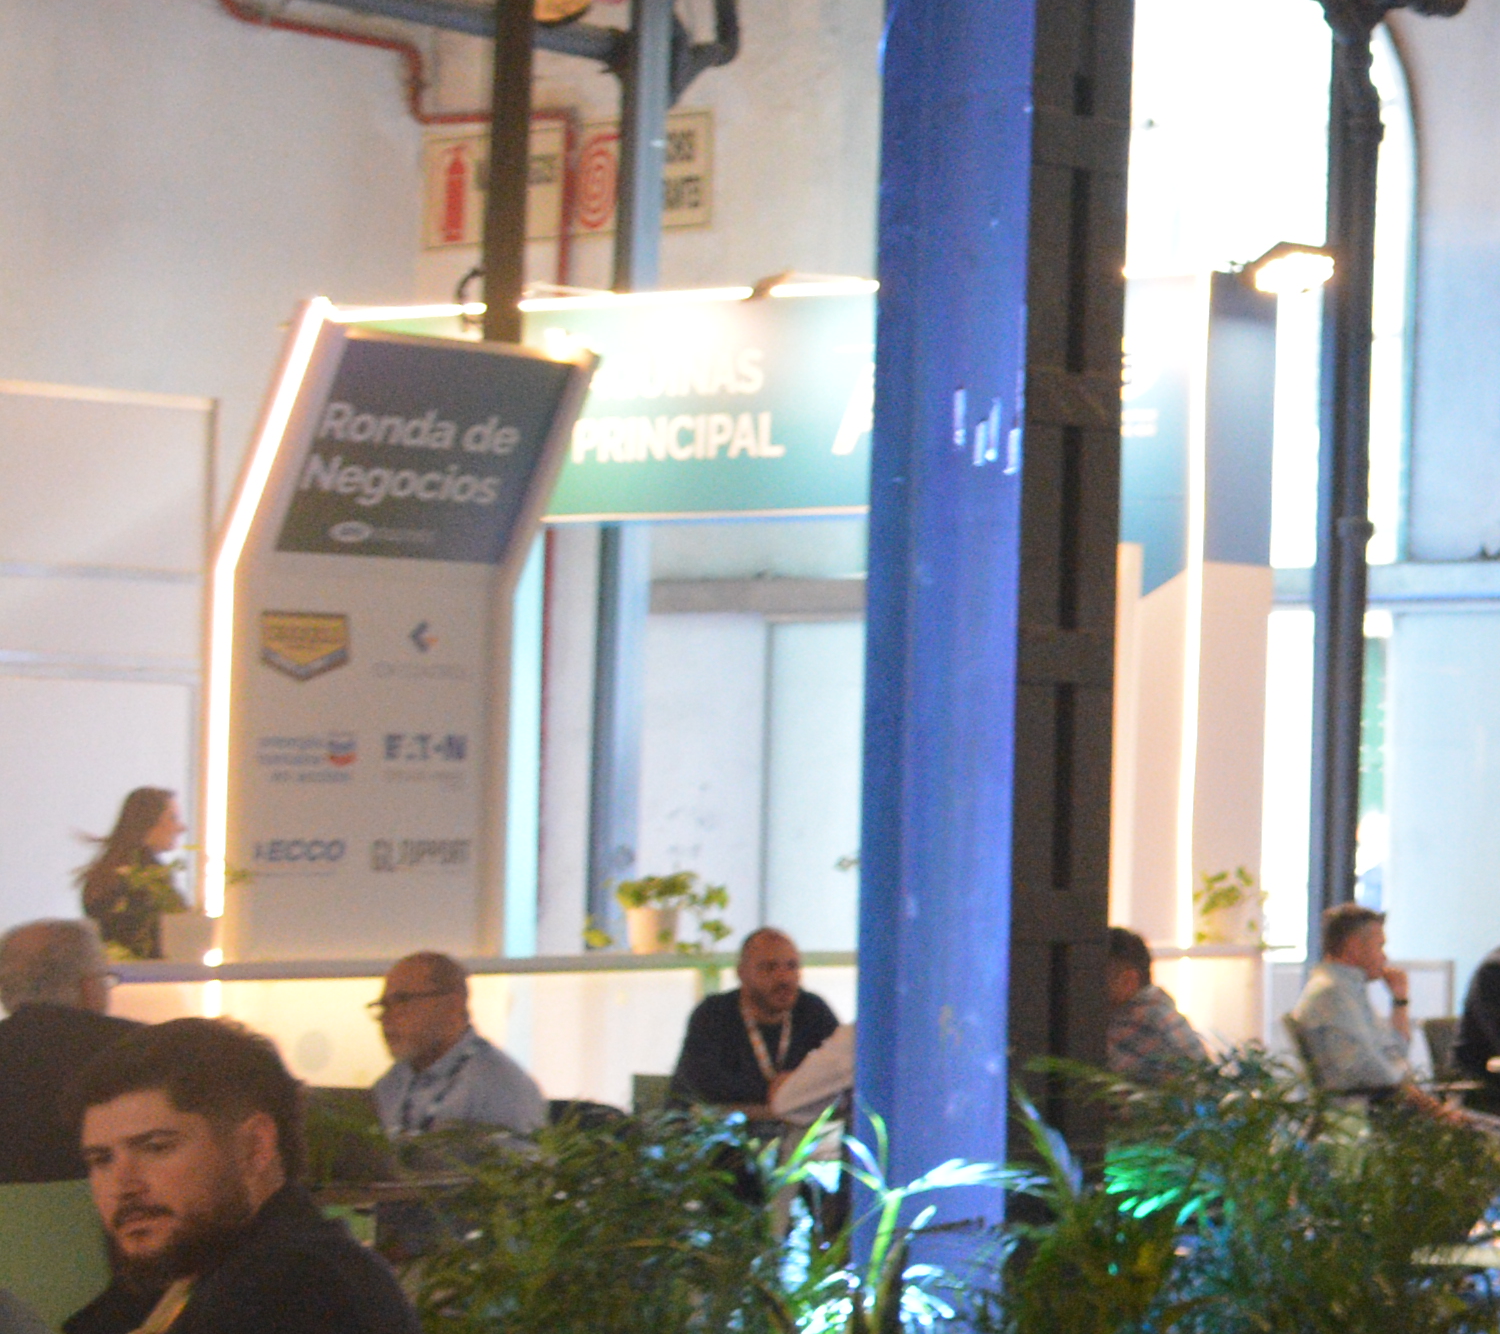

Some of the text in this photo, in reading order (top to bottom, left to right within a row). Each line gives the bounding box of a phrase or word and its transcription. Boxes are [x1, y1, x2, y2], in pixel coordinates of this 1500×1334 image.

[320, 402, 521, 454] Ronda de
[571, 412, 785, 464] PRINCIPAL
[301, 453, 499, 506] Negocios
[268, 839, 346, 863] ECCO
